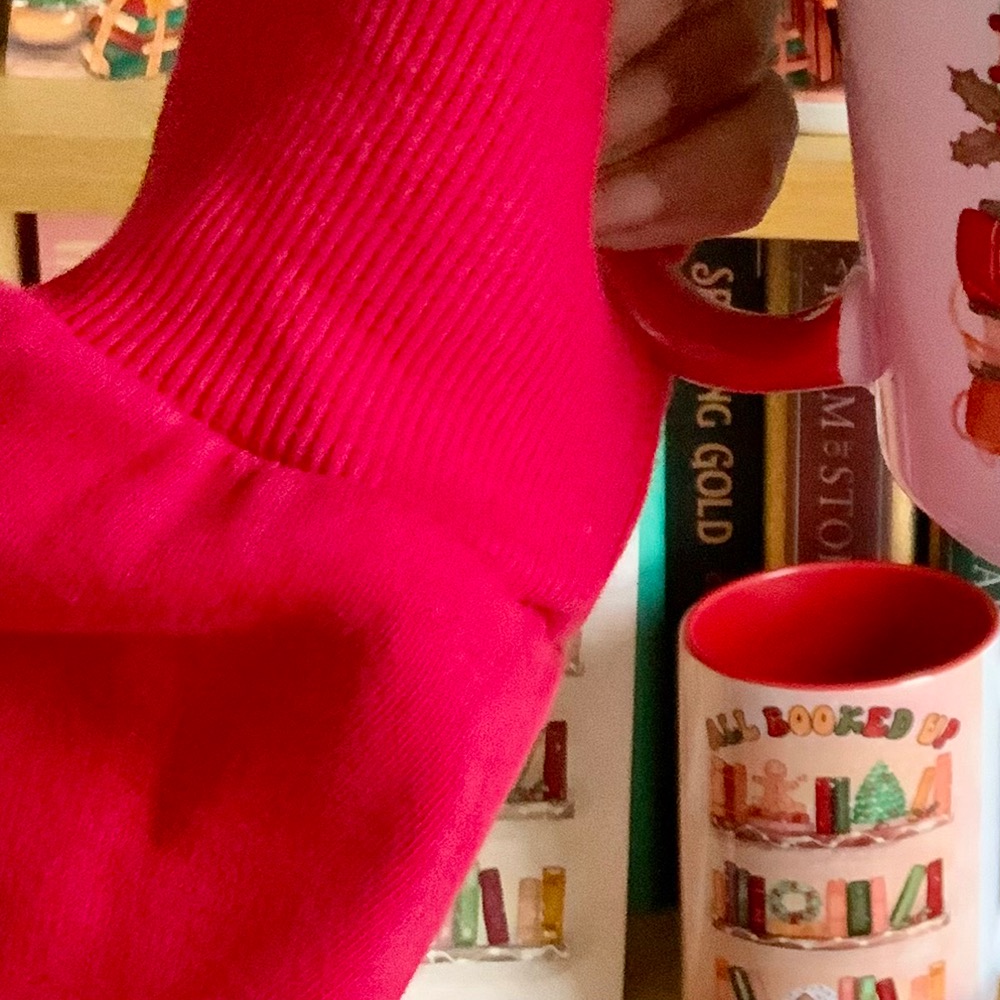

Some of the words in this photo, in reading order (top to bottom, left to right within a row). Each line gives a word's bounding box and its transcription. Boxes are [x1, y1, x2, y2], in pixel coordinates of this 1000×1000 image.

[690, 442, 735, 546] GOLD
[705, 707, 762, 752] ALL
[762, 704, 915, 740] BOOKED
